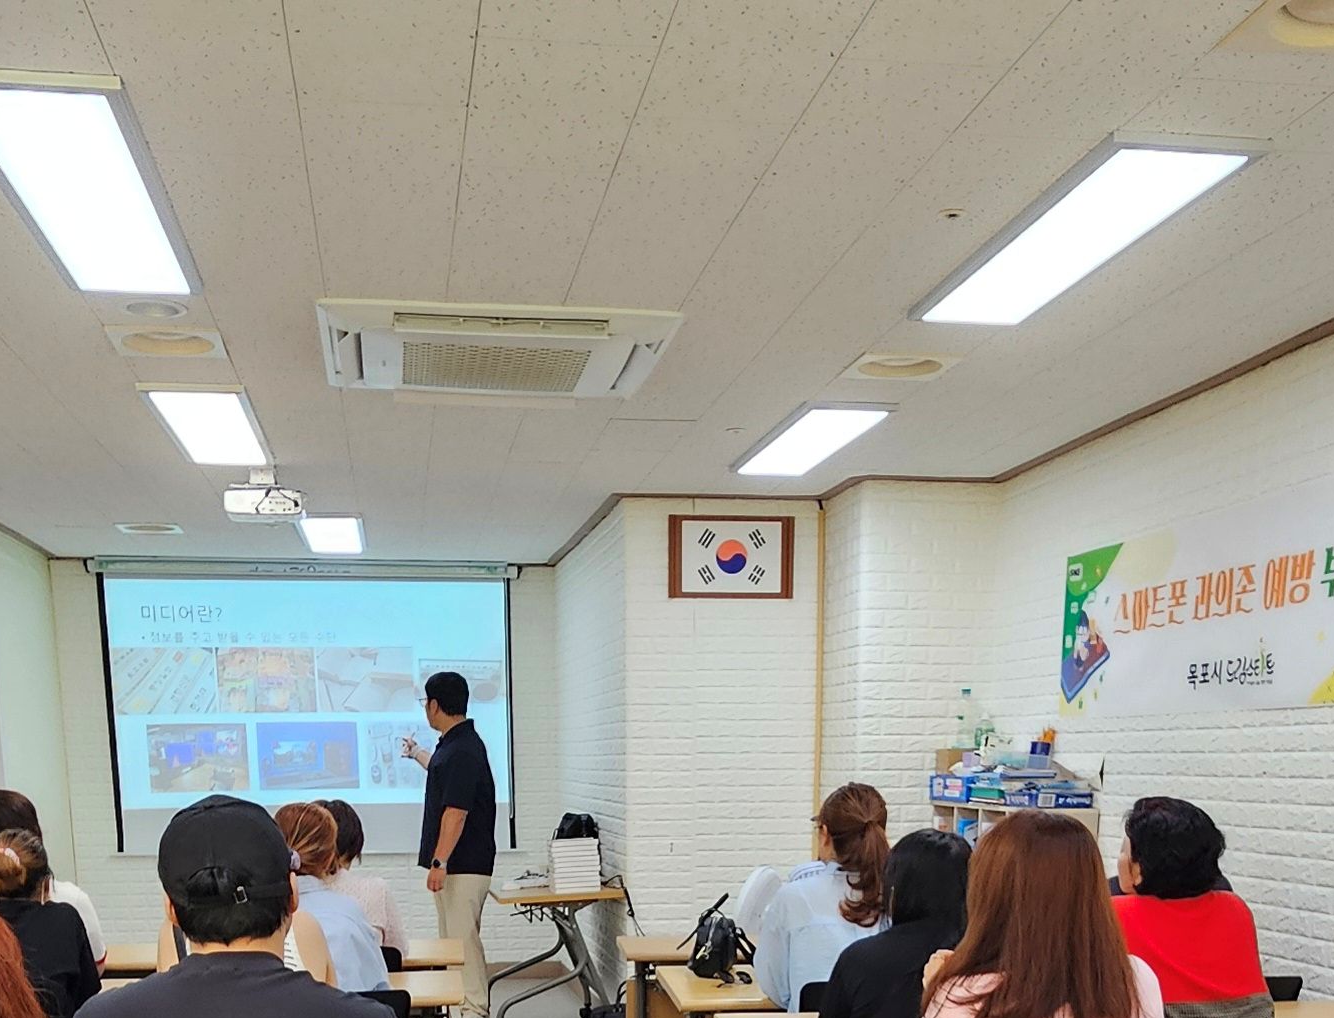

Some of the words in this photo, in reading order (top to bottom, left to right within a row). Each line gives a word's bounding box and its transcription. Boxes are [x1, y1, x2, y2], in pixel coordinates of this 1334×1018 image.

[1113, 579, 1188, 634] 스마트폰
[1192, 564, 1256, 620] 과의존
[1264, 550, 1316, 610] 예방
[140, 604, 223, 623] 미디어란?
[1187, 659, 1223, 690] 목포시
[1226, 651, 1275, 685] 드림스타트
